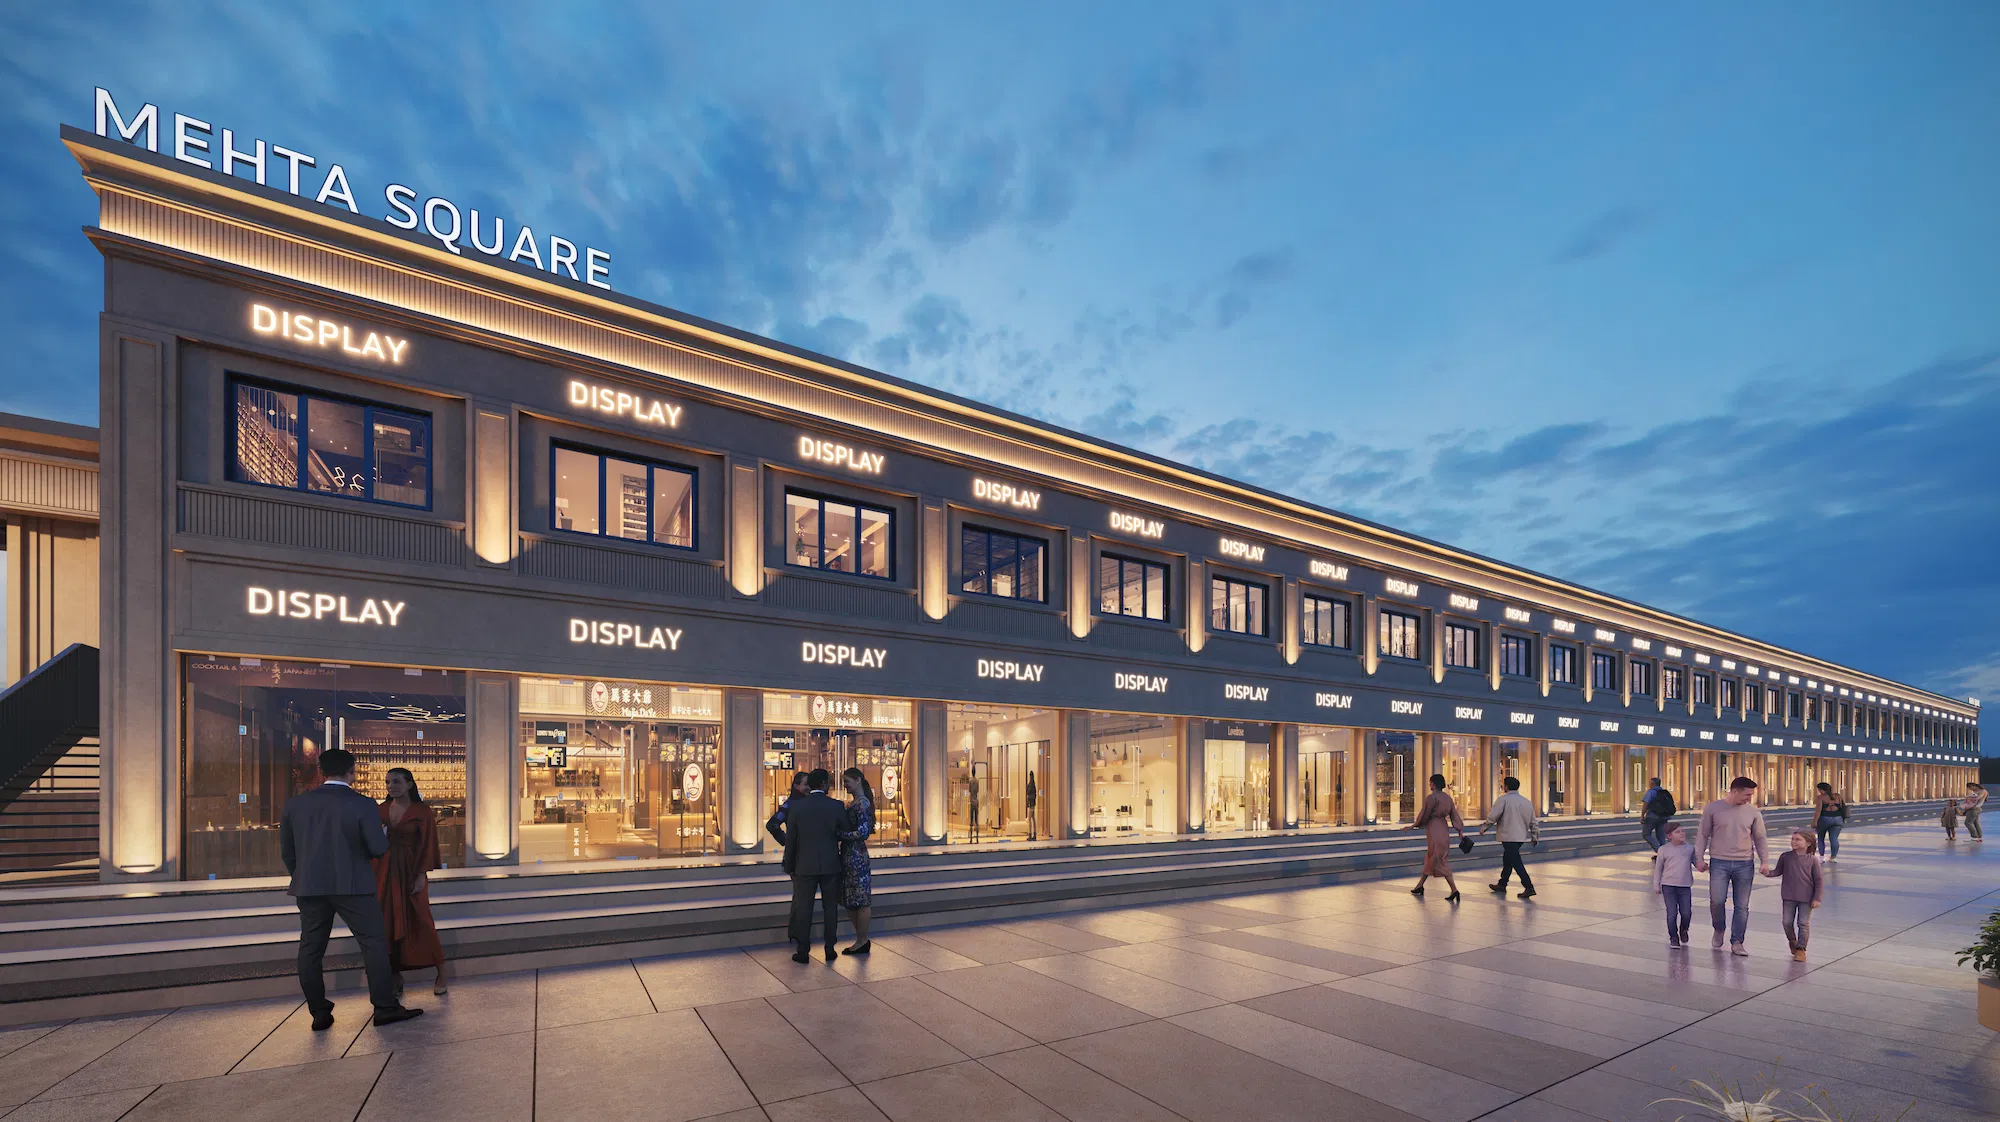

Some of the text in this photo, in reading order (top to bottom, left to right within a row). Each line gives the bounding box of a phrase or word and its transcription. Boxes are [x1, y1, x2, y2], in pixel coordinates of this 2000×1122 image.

[95, 86, 612, 291] MEHTA SQUARE
[252, 304, 407, 363] DISPLAY
[571, 381, 682, 427] DISPLAY
[801, 437, 884, 472] DISPLAY
[975, 479, 1040, 509] DISPLAY
[1112, 512, 1164, 537] DISPLAY
[1221, 539, 1264, 561] DISPLAY
[1311, 560, 1348, 580] DISPLAY
[1387, 579, 1418, 596] DISPLAY
[249, 587, 404, 626] DISPLAY
[1451, 594, 1478, 610] DISPLAY
[1506, 608, 1530, 622] DISPLAY
[571, 619, 682, 650] DISPLAY
[1554, 619, 1575, 632] DISPLAY
[803, 642, 886, 668] DISPLAY
[191, 663, 229, 671] COCKTAIL
[978, 659, 1043, 681] DISPLAY
[1115, 673, 1168, 692] DISPLAY
[1226, 684, 1268, 701] DISPLAY
[1316, 693, 1352, 708] DISPLAY
[1392, 700, 1422, 714] DISPLAY
[1456, 707, 1482, 719] DISPLAY
[1511, 712, 1534, 724] DISPLAY
[1559, 717, 1579, 728] DISPLAY
